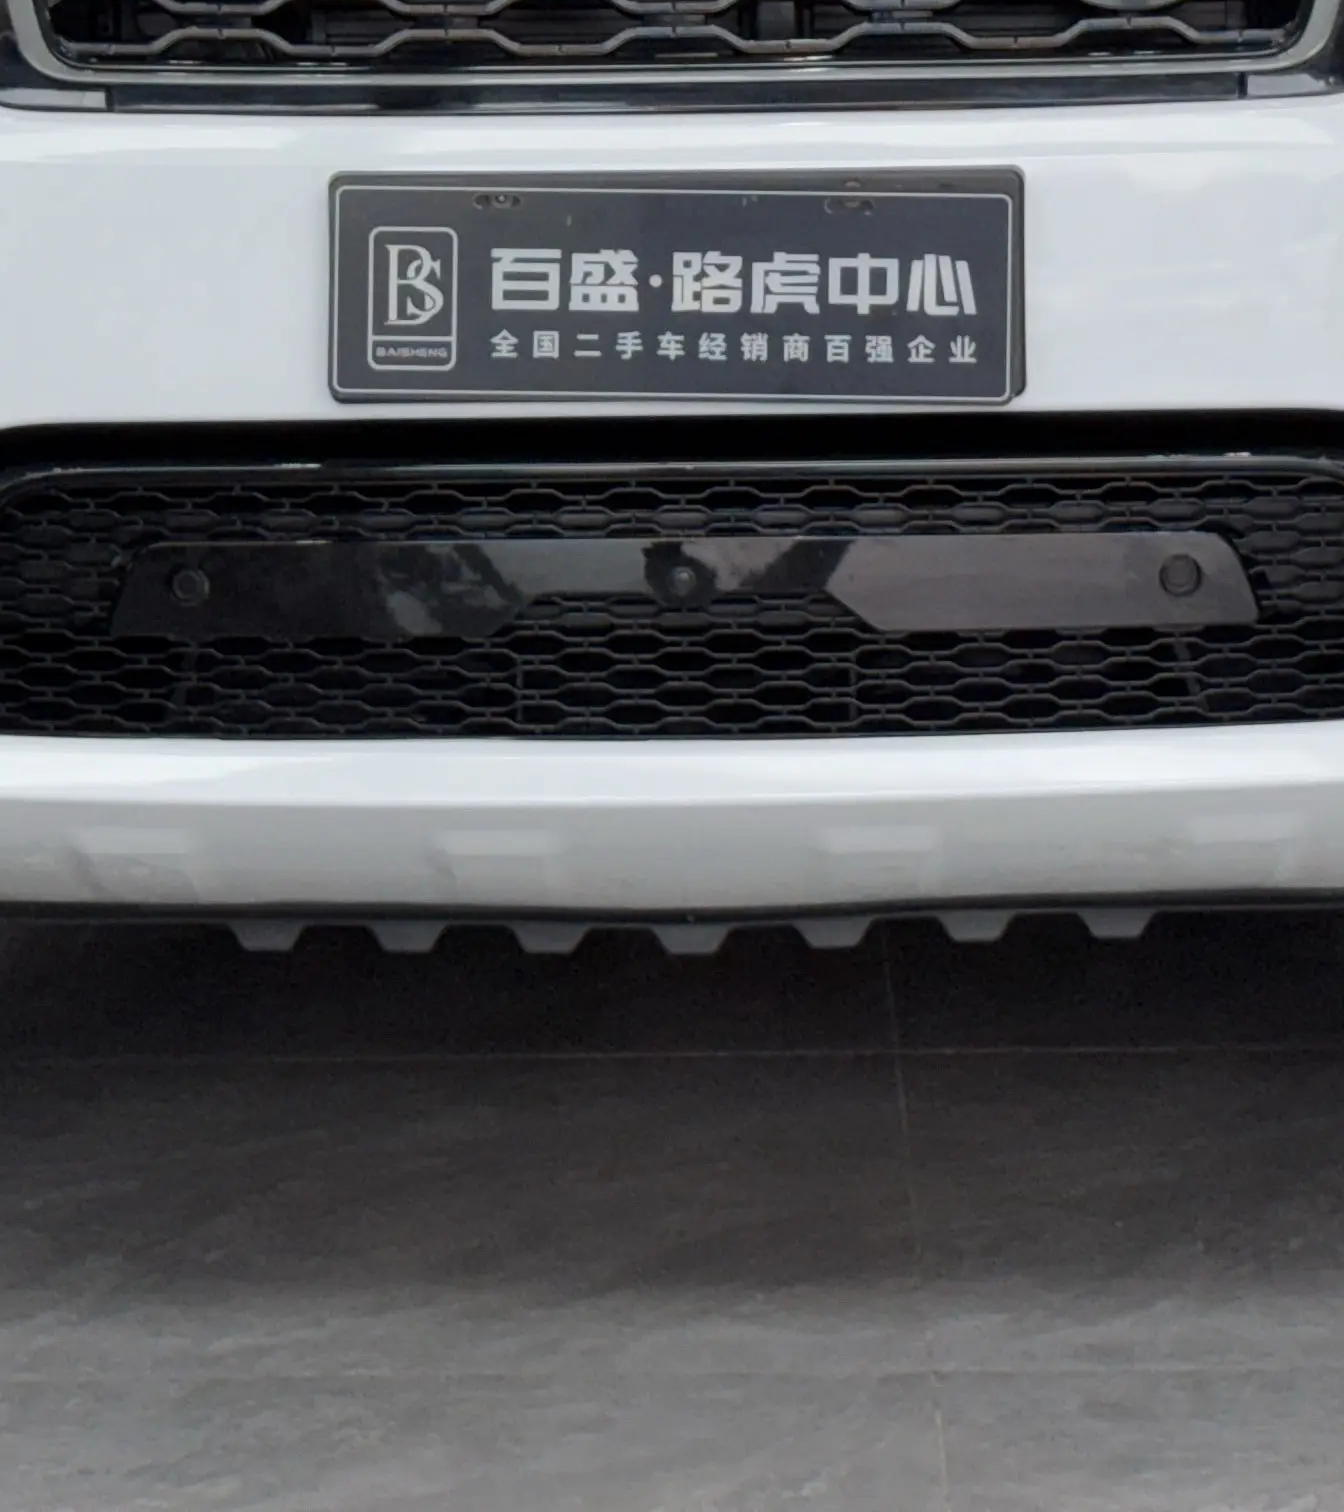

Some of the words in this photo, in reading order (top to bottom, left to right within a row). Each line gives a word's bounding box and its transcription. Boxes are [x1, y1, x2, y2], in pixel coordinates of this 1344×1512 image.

[490, 247, 978, 316] 百盛·路虎中心
[490, 329, 978, 364] 全国二手车经销商百强企业
